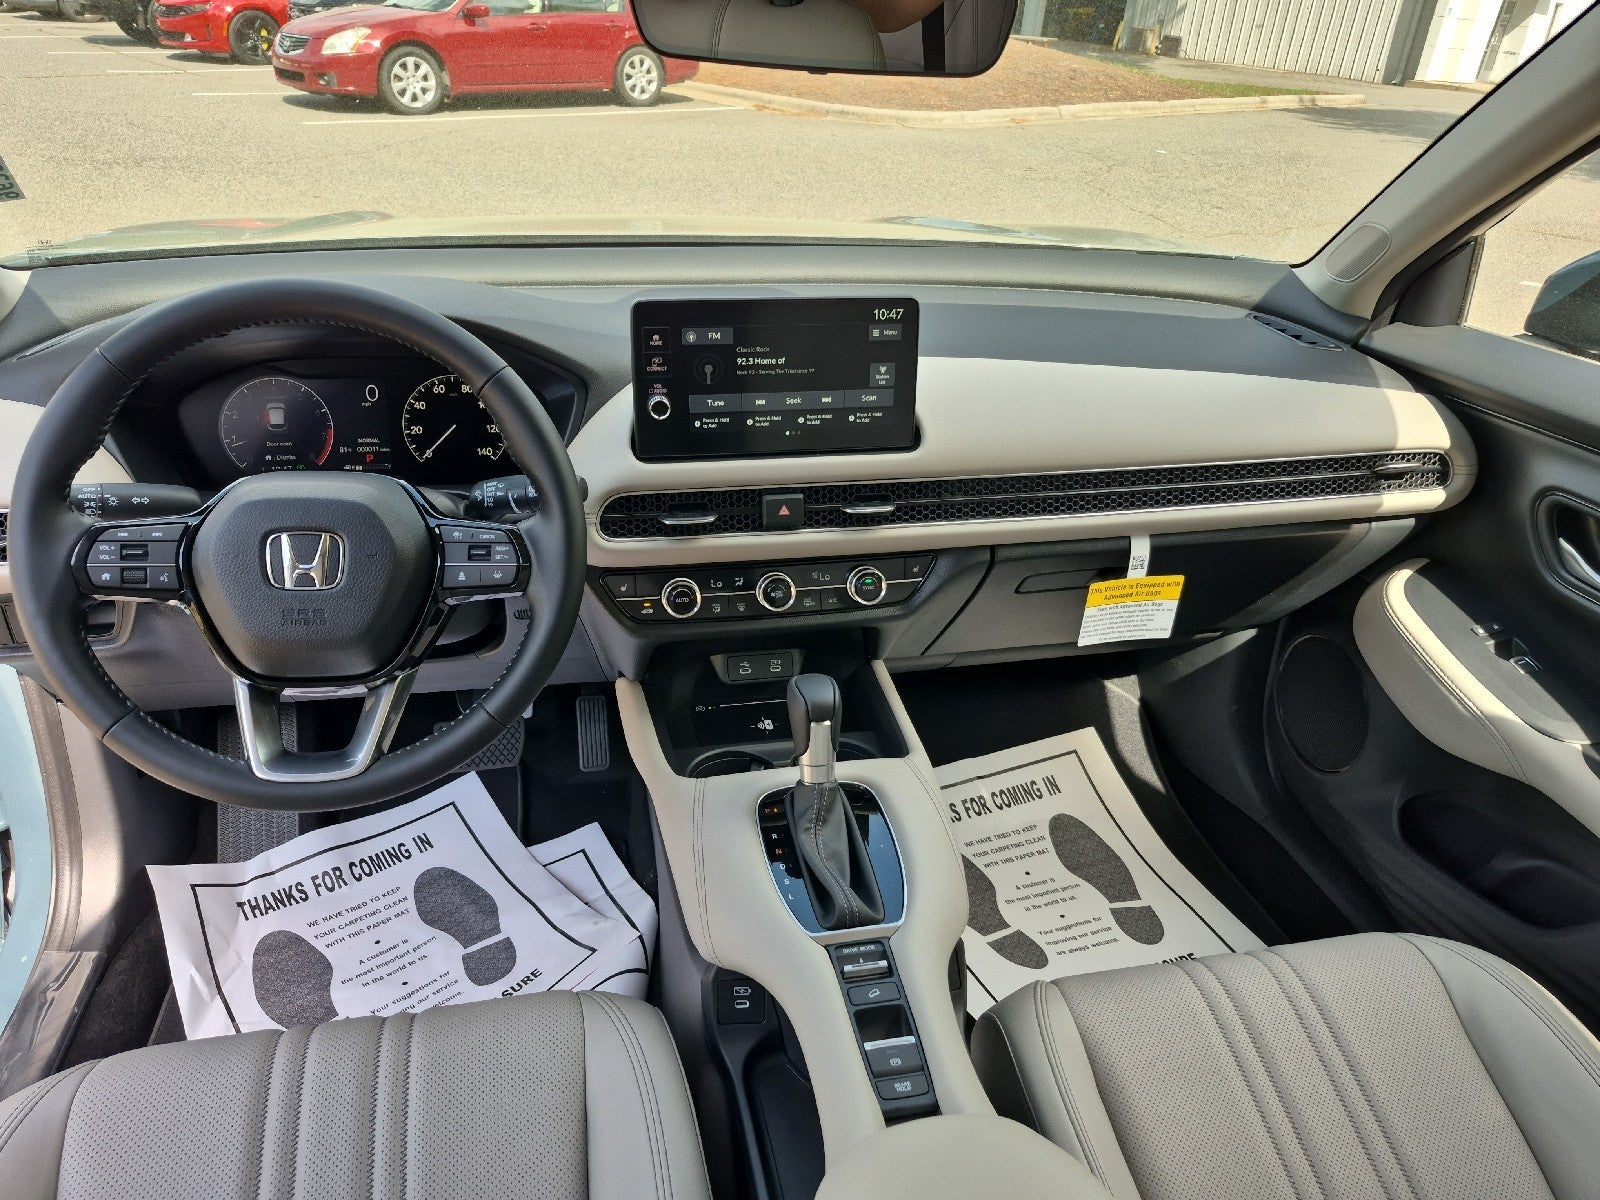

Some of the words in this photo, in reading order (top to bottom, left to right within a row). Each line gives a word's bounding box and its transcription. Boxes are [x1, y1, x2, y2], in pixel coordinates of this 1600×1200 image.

[873, 308, 904, 320] 10:47
[736, 357, 754, 366] 92.3
[778, 356, 786, 364] of
[365, 384, 379, 402] 0
[433, 384, 446, 394] 60
[462, 384, 473, 394] 80
[414, 402, 426, 410] 40
[232, 410, 238, 418] 2
[410, 426, 422, 434] 20
[426, 450, 432, 458] 0
[476, 448, 492, 456] 140
[366, 454, 374, 463] P
[819, 572, 830, 581] Lo
[710, 580, 722, 588] Lo
[1104, 585, 1126, 593] Vehicle
[1136, 581, 1165, 590] Equipped
[1104, 592, 1133, 601] Advanced
[960, 794, 992, 818] FOR
[990, 780, 1044, 811] COMING
[1042, 774, 1062, 796] IN
[976, 836, 994, 845] HAVE
[994, 832, 1012, 841] TRIED
[1022, 824, 1038, 833] KEEP
[971, 850, 990, 859] YOUR
[990, 842, 1025, 856] CARPETING
[1026, 835, 1046, 845] CLEAN
[983, 860, 1000, 869] WITH
[1000, 856, 1015, 865] THIS
[1015, 851, 1035, 862] PAPER
[1036, 848, 1050, 856] MAT
[236, 882, 310, 922] THANKS
[310, 866, 348, 898] FOR
[348, 842, 412, 883] COMING
[411, 832, 434, 851] IN
[1031, 888, 1060, 899] important
[1060, 882, 1080, 894] person
[306, 919, 321, 928] WE
[322, 910, 344, 922] HAVE
[345, 902, 368, 914] TRIED
[381, 886, 402, 899] KEEP
[1043, 898, 1059, 907] world
[314, 928, 336, 940] YOUR
[338, 908, 382, 930] CARPETING
[383, 896, 408, 911] CLEAN
[324, 937, 346, 949] WITH
[346, 928, 366, 940] THIS
[366, 917, 393, 932] PAPER
[394, 908, 410, 919] MAT
[1055, 919, 1092, 932] suggestions
[1090, 926, 1112, 936] service
[366, 943, 400, 962] customer
[1067, 945, 1089, 954] always
[341, 976, 354, 985] the
[355, 967, 374, 979] most
[376, 950, 412, 970] important
[412, 935, 437, 953] person
[372, 975, 385, 984] the
[386, 964, 408, 978] world
[370, 1004, 390, 1015] Your
[392, 978, 438, 1005] suggestions
[439, 970, 450, 980] for
[417, 994, 430, 1005] our
[432, 979, 459, 996] service
